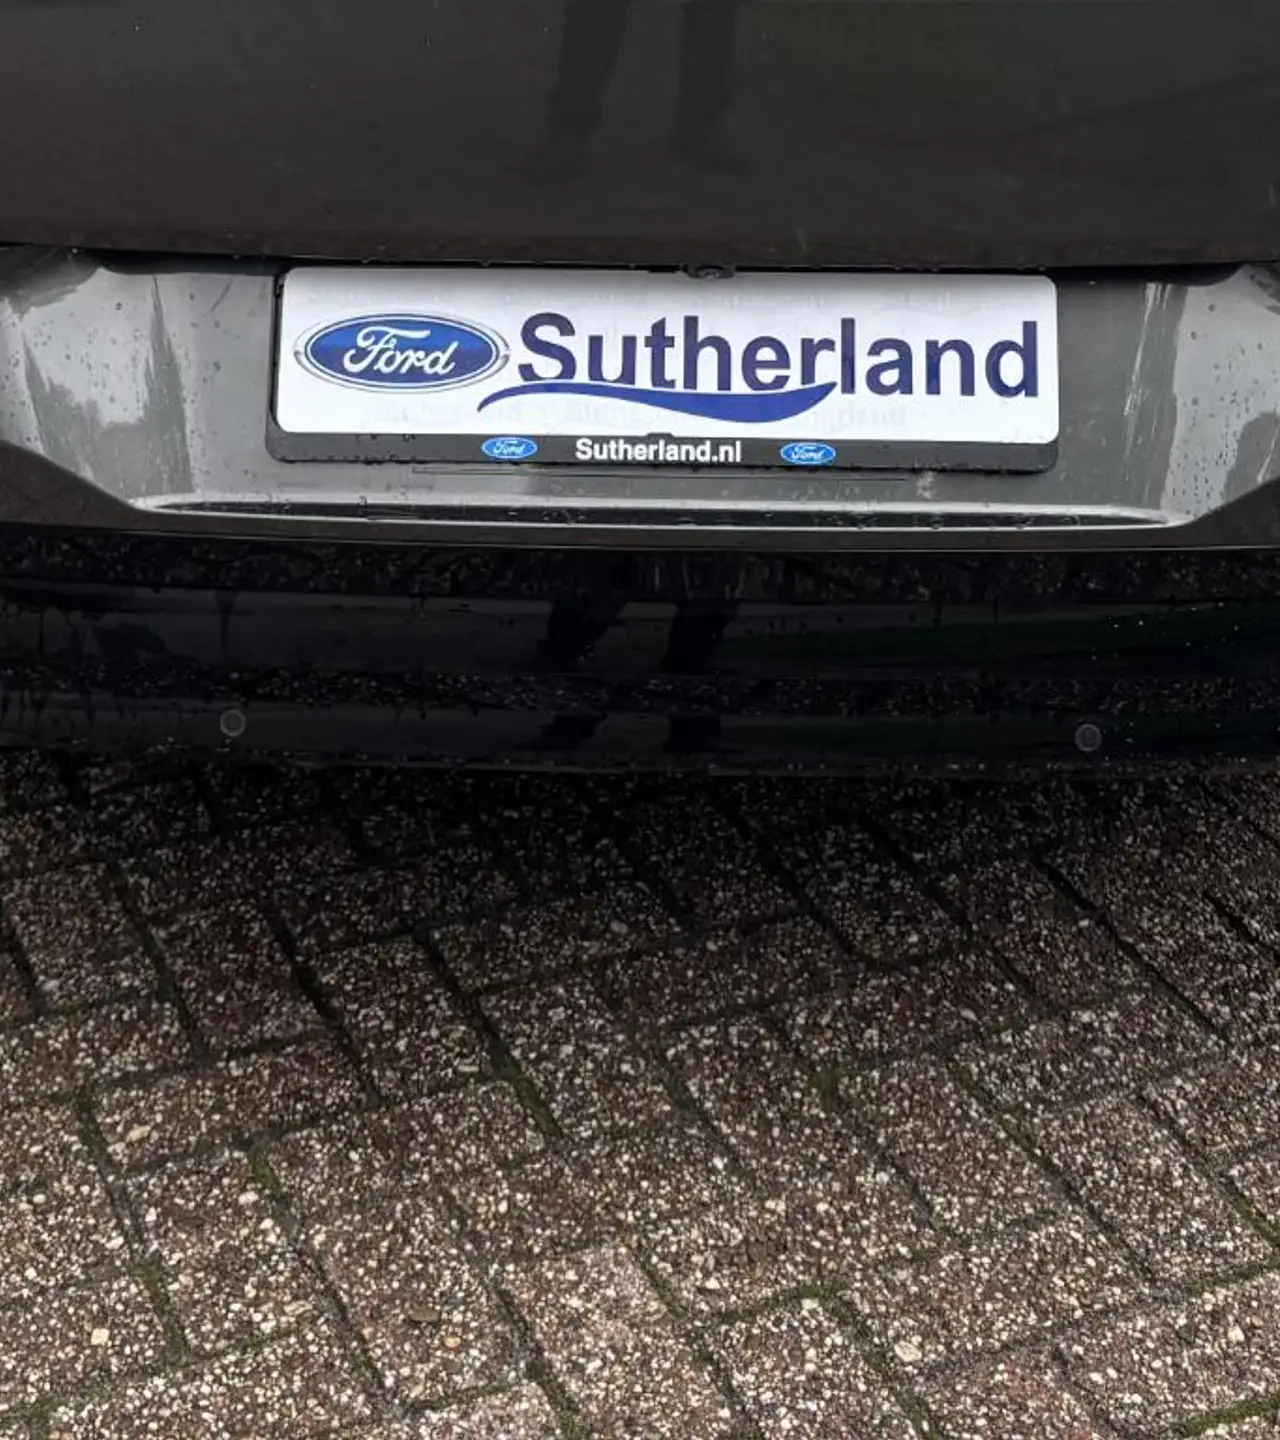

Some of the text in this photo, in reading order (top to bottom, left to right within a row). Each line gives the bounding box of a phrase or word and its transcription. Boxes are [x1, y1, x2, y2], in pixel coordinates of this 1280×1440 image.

[342, 312, 1039, 398] Ford Sutherland
[575, 438, 742, 463] Sutherland.nl
